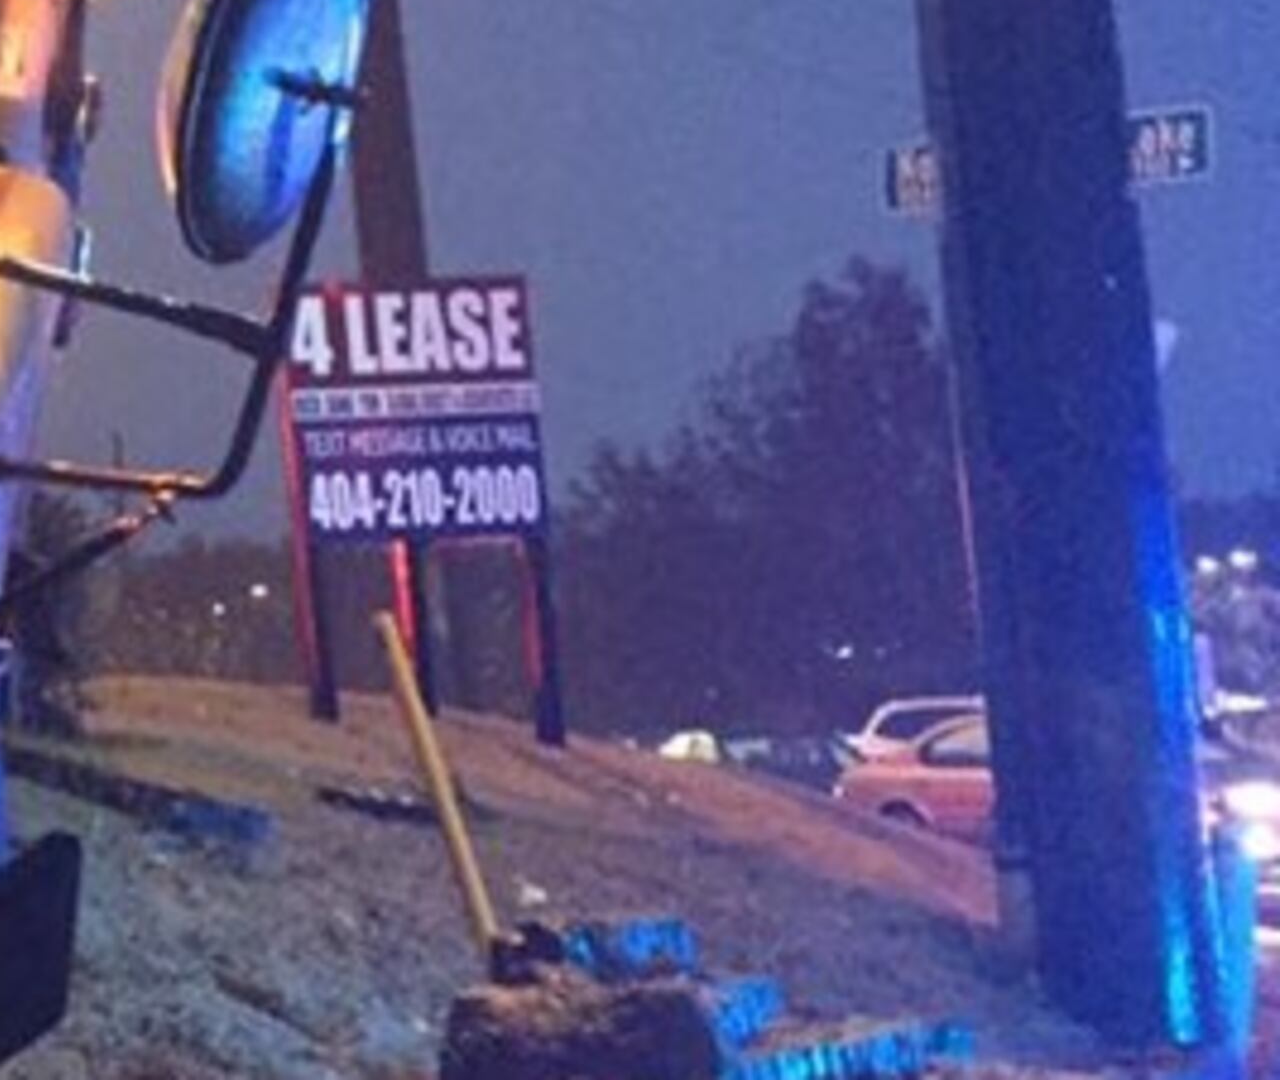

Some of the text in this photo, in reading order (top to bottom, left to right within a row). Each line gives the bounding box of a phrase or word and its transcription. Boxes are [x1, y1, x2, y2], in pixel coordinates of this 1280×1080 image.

[291, 287, 525, 375] 4 LEASE
[304, 429, 345, 459] TEXT
[309, 464, 540, 530] 404-210-2000
